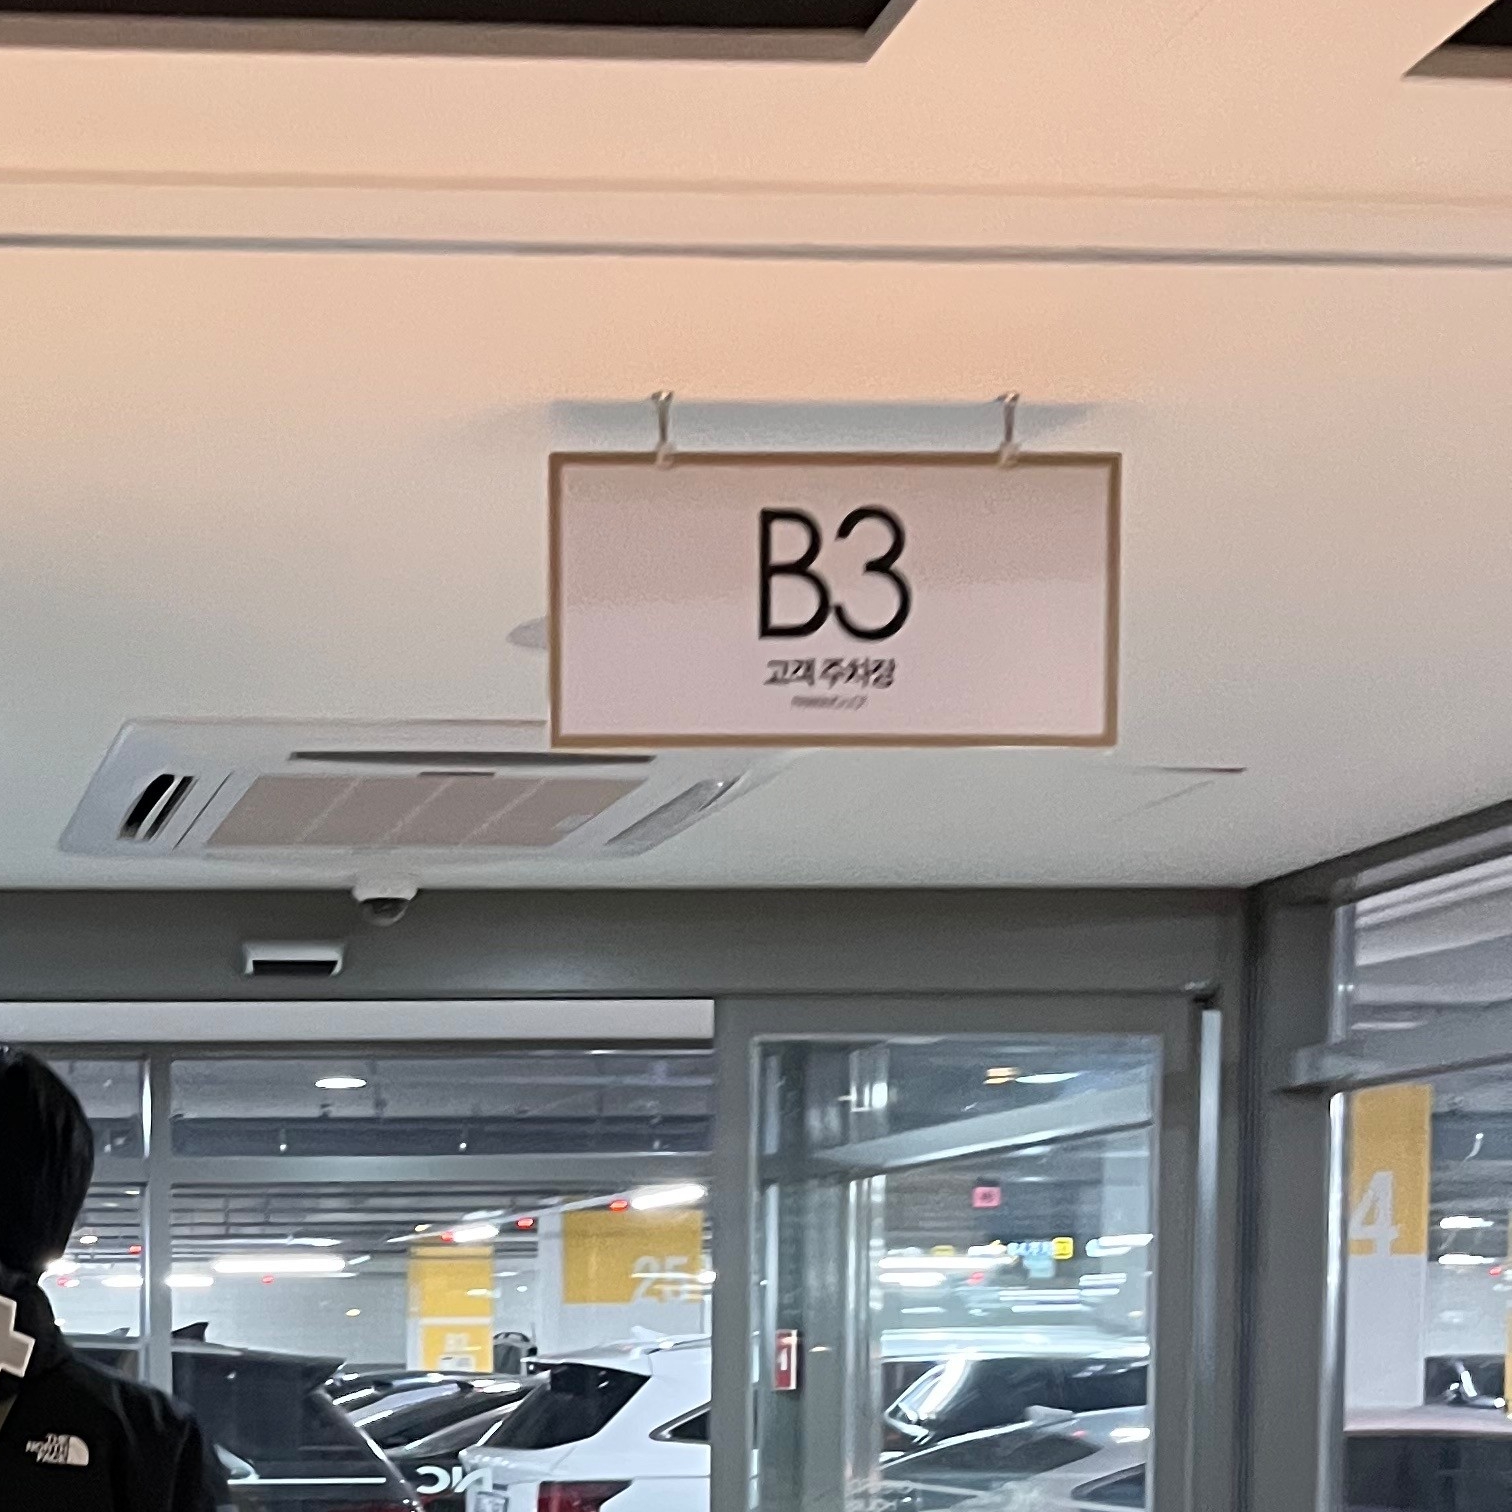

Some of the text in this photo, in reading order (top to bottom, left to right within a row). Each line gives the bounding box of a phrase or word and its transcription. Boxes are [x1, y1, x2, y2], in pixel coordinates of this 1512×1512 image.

[758, 504, 912, 641] B3
[763, 658, 896, 690] 고객 주차장
